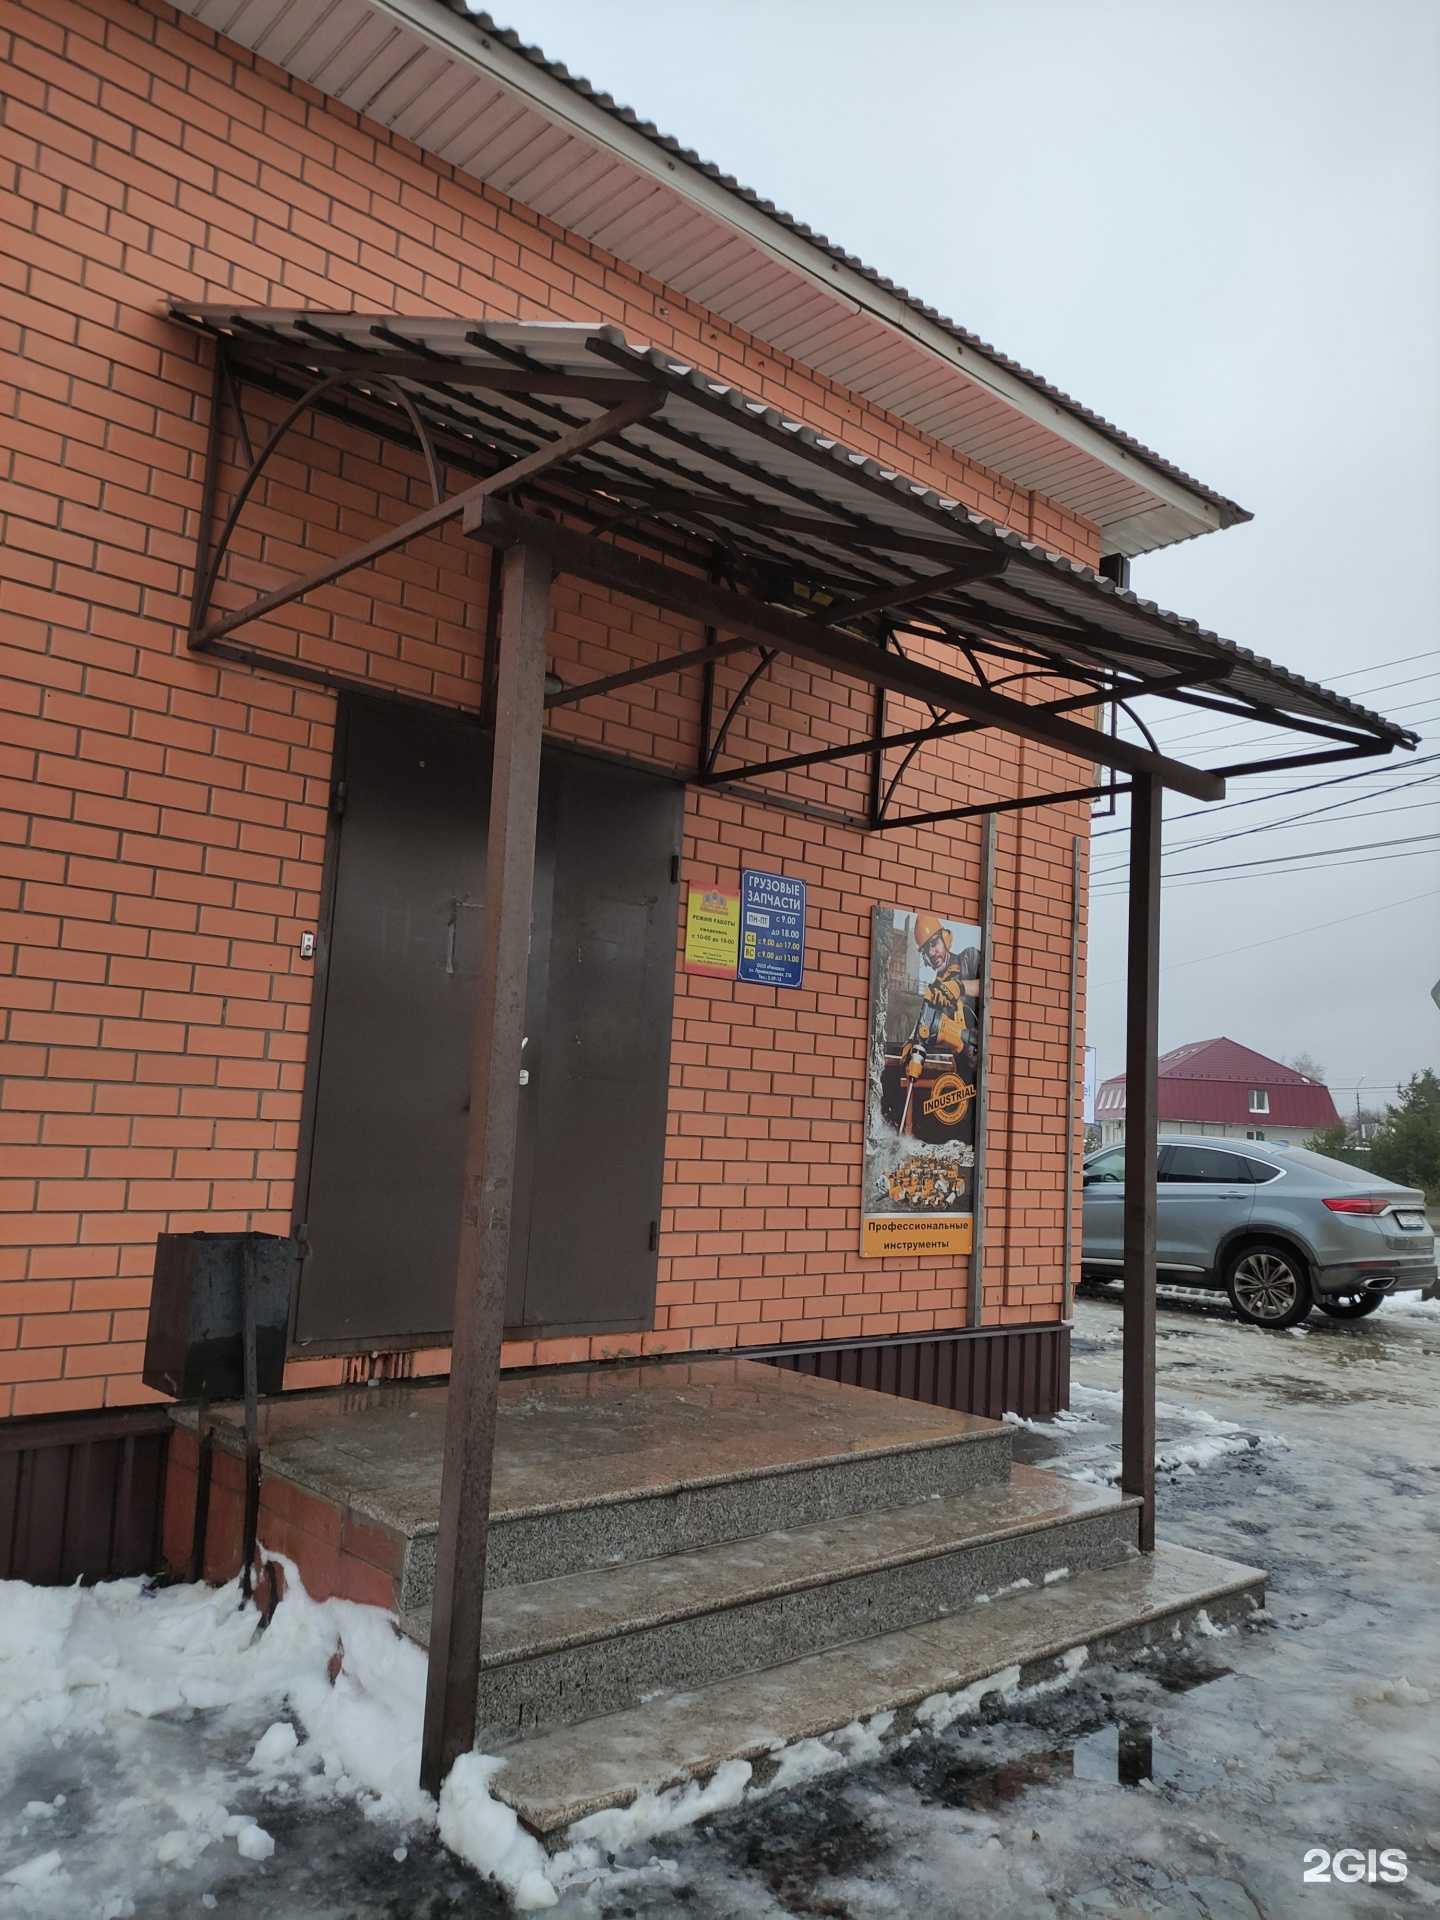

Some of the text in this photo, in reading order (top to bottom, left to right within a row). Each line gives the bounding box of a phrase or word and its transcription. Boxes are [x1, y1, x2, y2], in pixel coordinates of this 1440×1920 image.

[749, 875, 800, 897] ГРУЗОВЫЕ
[747, 890, 801, 910] ЗАПЧАСТИ
[781, 915, 796, 925] 9.00
[781, 929, 800, 939] 18.00
[925, 1085, 975, 1113] INDUSTRIAL
[868, 1221, 969, 1232] Профессиональные
[883, 1240, 949, 1251] инструменты
